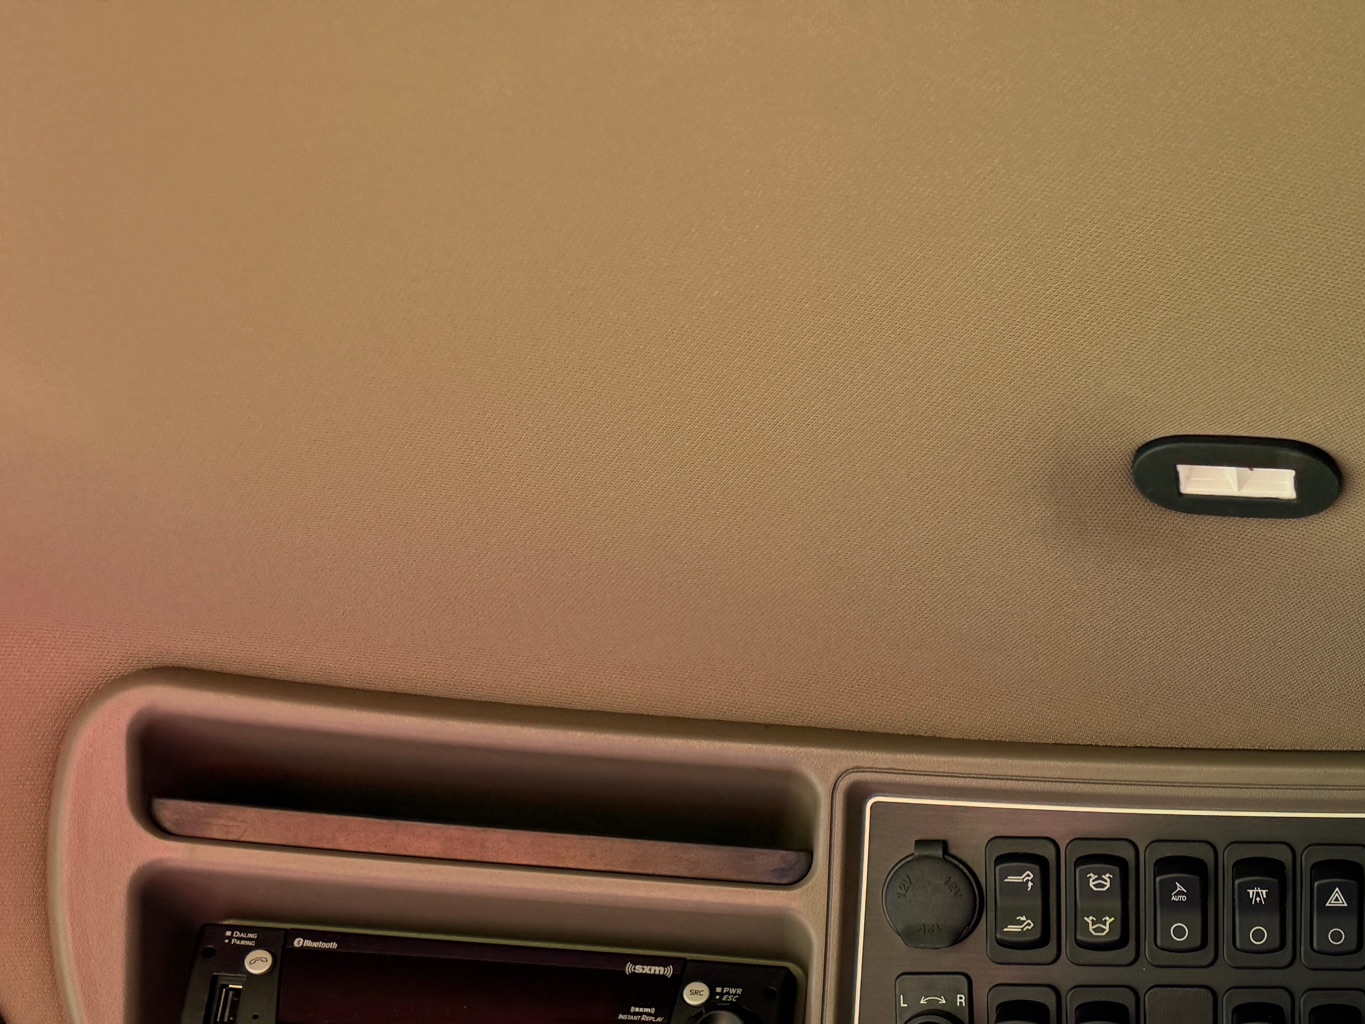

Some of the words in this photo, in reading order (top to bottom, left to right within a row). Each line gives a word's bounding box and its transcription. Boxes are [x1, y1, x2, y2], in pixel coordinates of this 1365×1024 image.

[303, 940, 338, 949] Bluetooth
[900, 994, 908, 1007] L
[956, 994, 966, 1007] R
